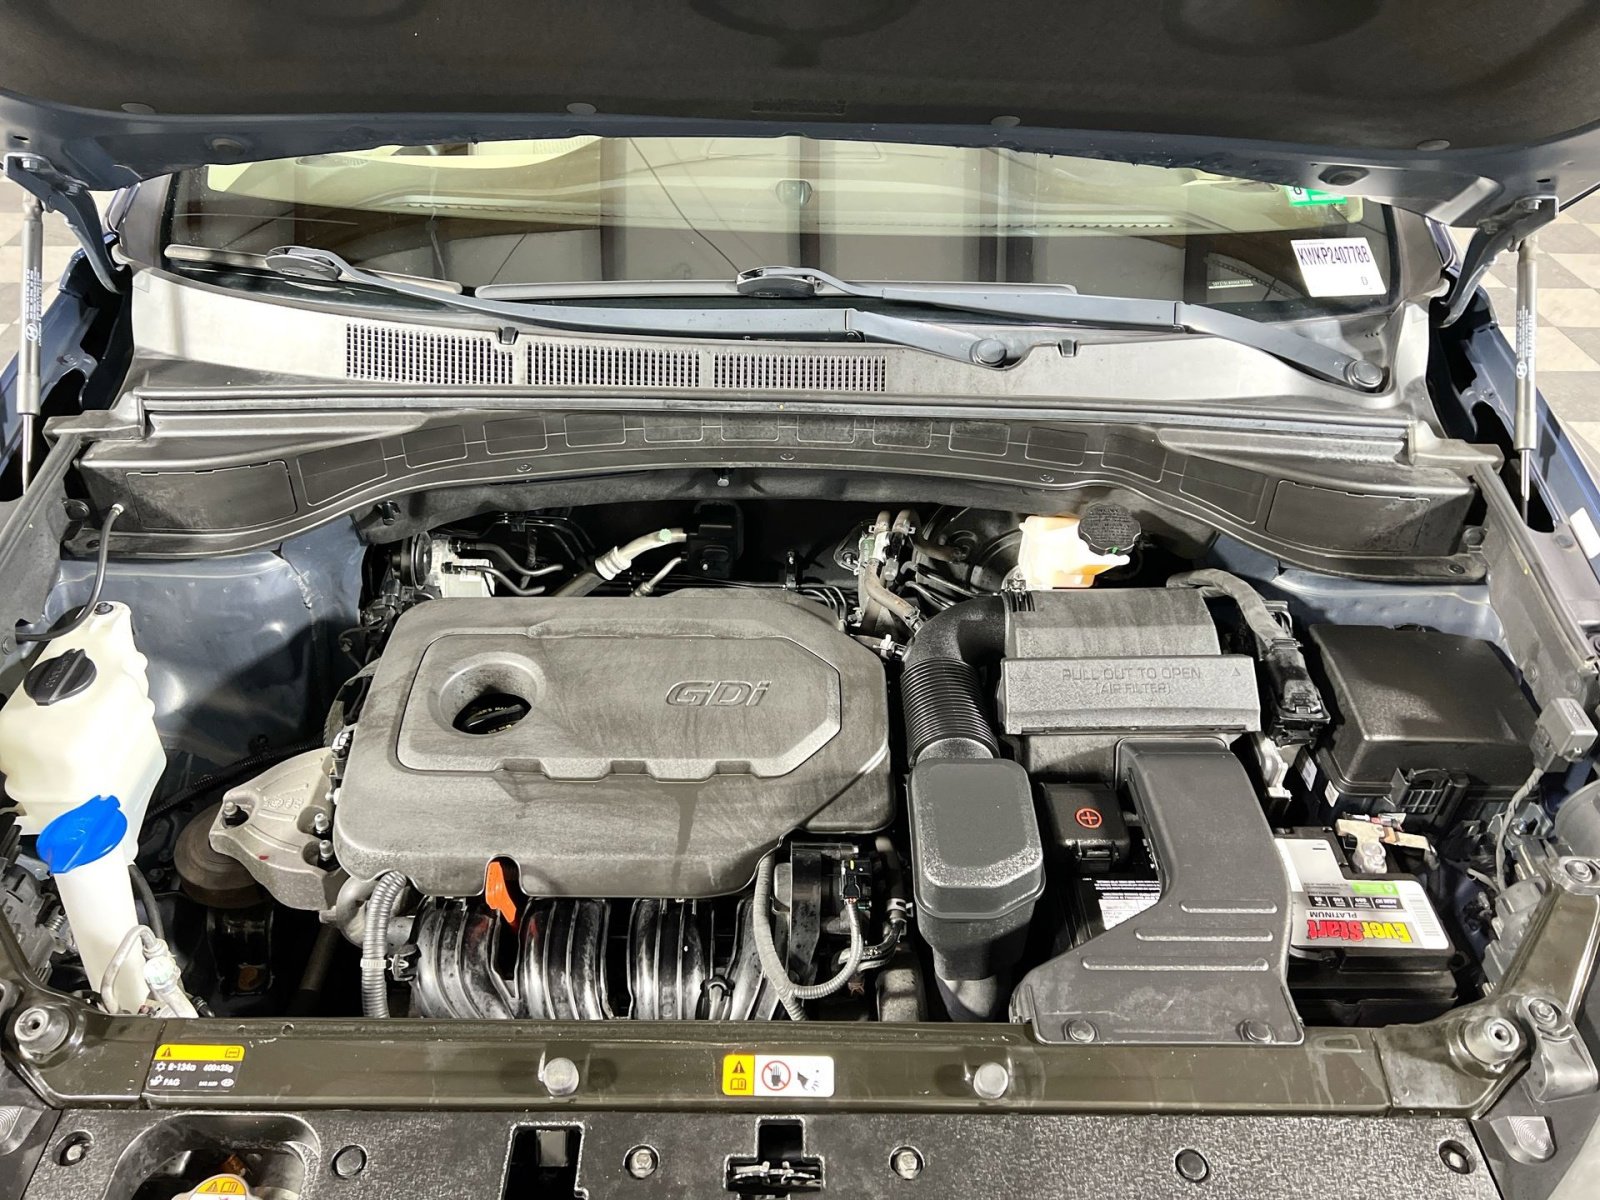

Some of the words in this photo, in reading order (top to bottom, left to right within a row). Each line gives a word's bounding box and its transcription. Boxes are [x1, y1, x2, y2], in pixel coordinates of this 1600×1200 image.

[1062, 668, 1099, 680] PULL
[1103, 668, 1136, 680] OUT
[1137, 667, 1157, 680] TO
[1162, 667, 1201, 679] OPEN
[665, 680, 772, 706] GDi
[1307, 920, 1412, 943] EverStart
[163, 1078, 180, 1086] PAG
